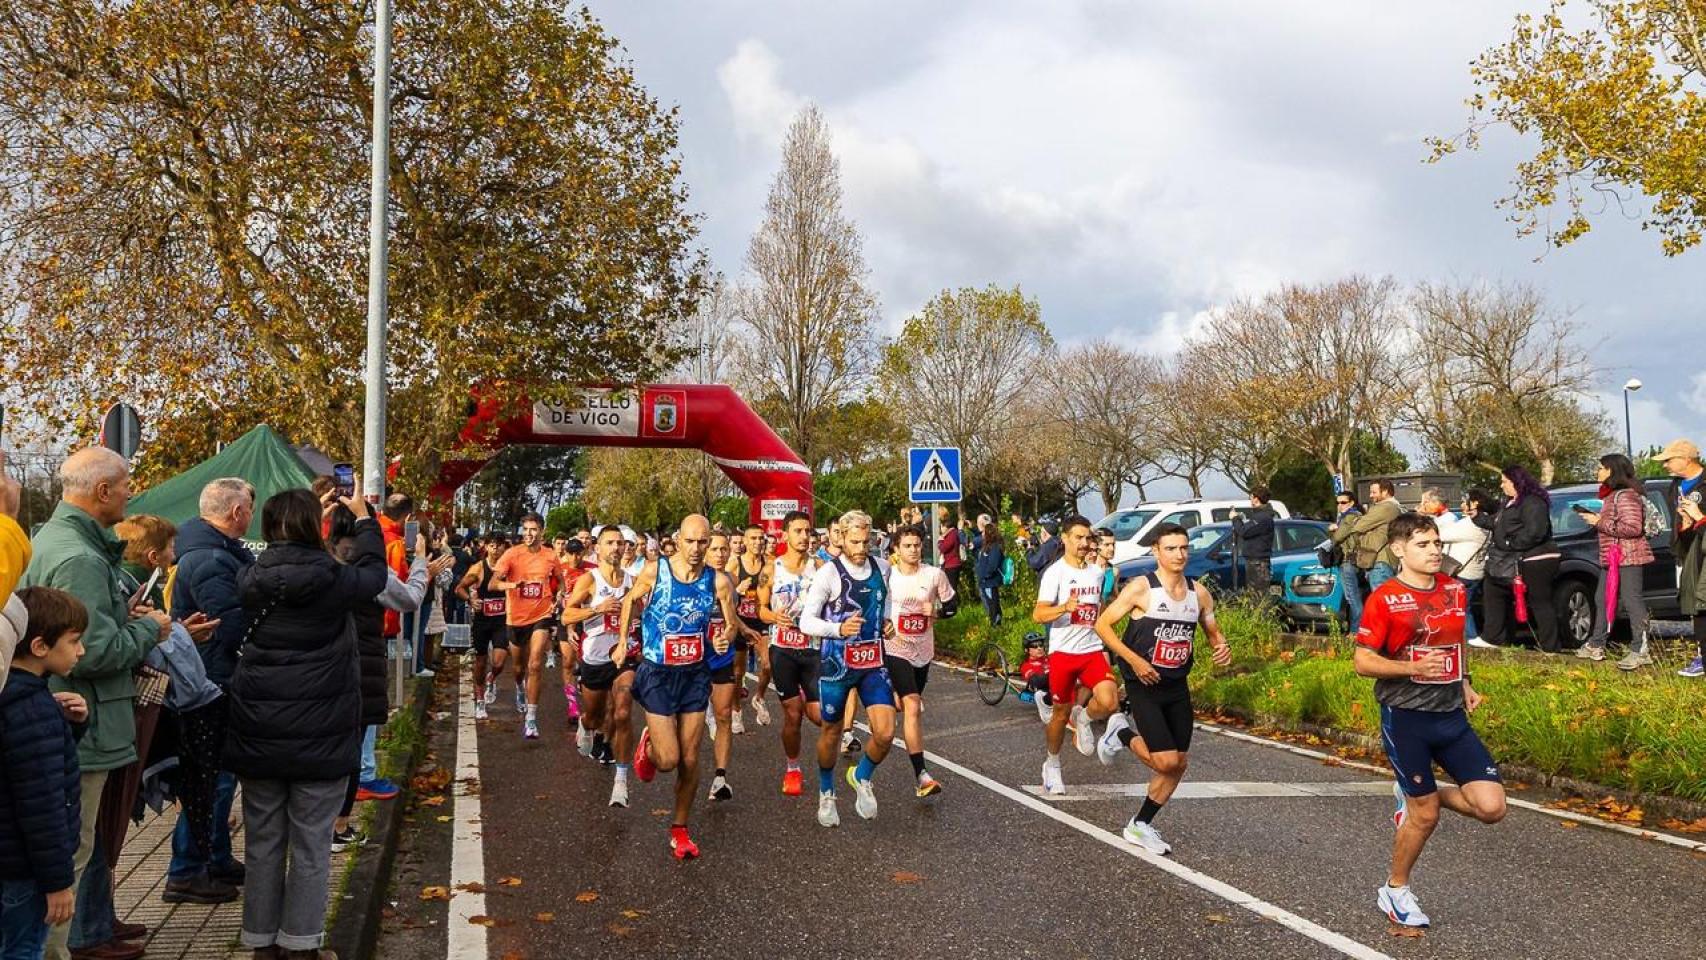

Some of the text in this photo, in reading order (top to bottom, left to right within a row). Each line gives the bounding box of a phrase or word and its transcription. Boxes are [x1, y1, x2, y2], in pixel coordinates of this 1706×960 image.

[551, 411, 620, 426] DE VIGO
[763, 503, 797, 511] CONCELLO
[1077, 610, 1097, 621] 962
[903, 619, 924, 630] 825
[781, 631, 804, 644] 1013
[671, 643, 697, 657] 384
[852, 649, 875, 662] 390
[1160, 647, 1189, 661] 1028
